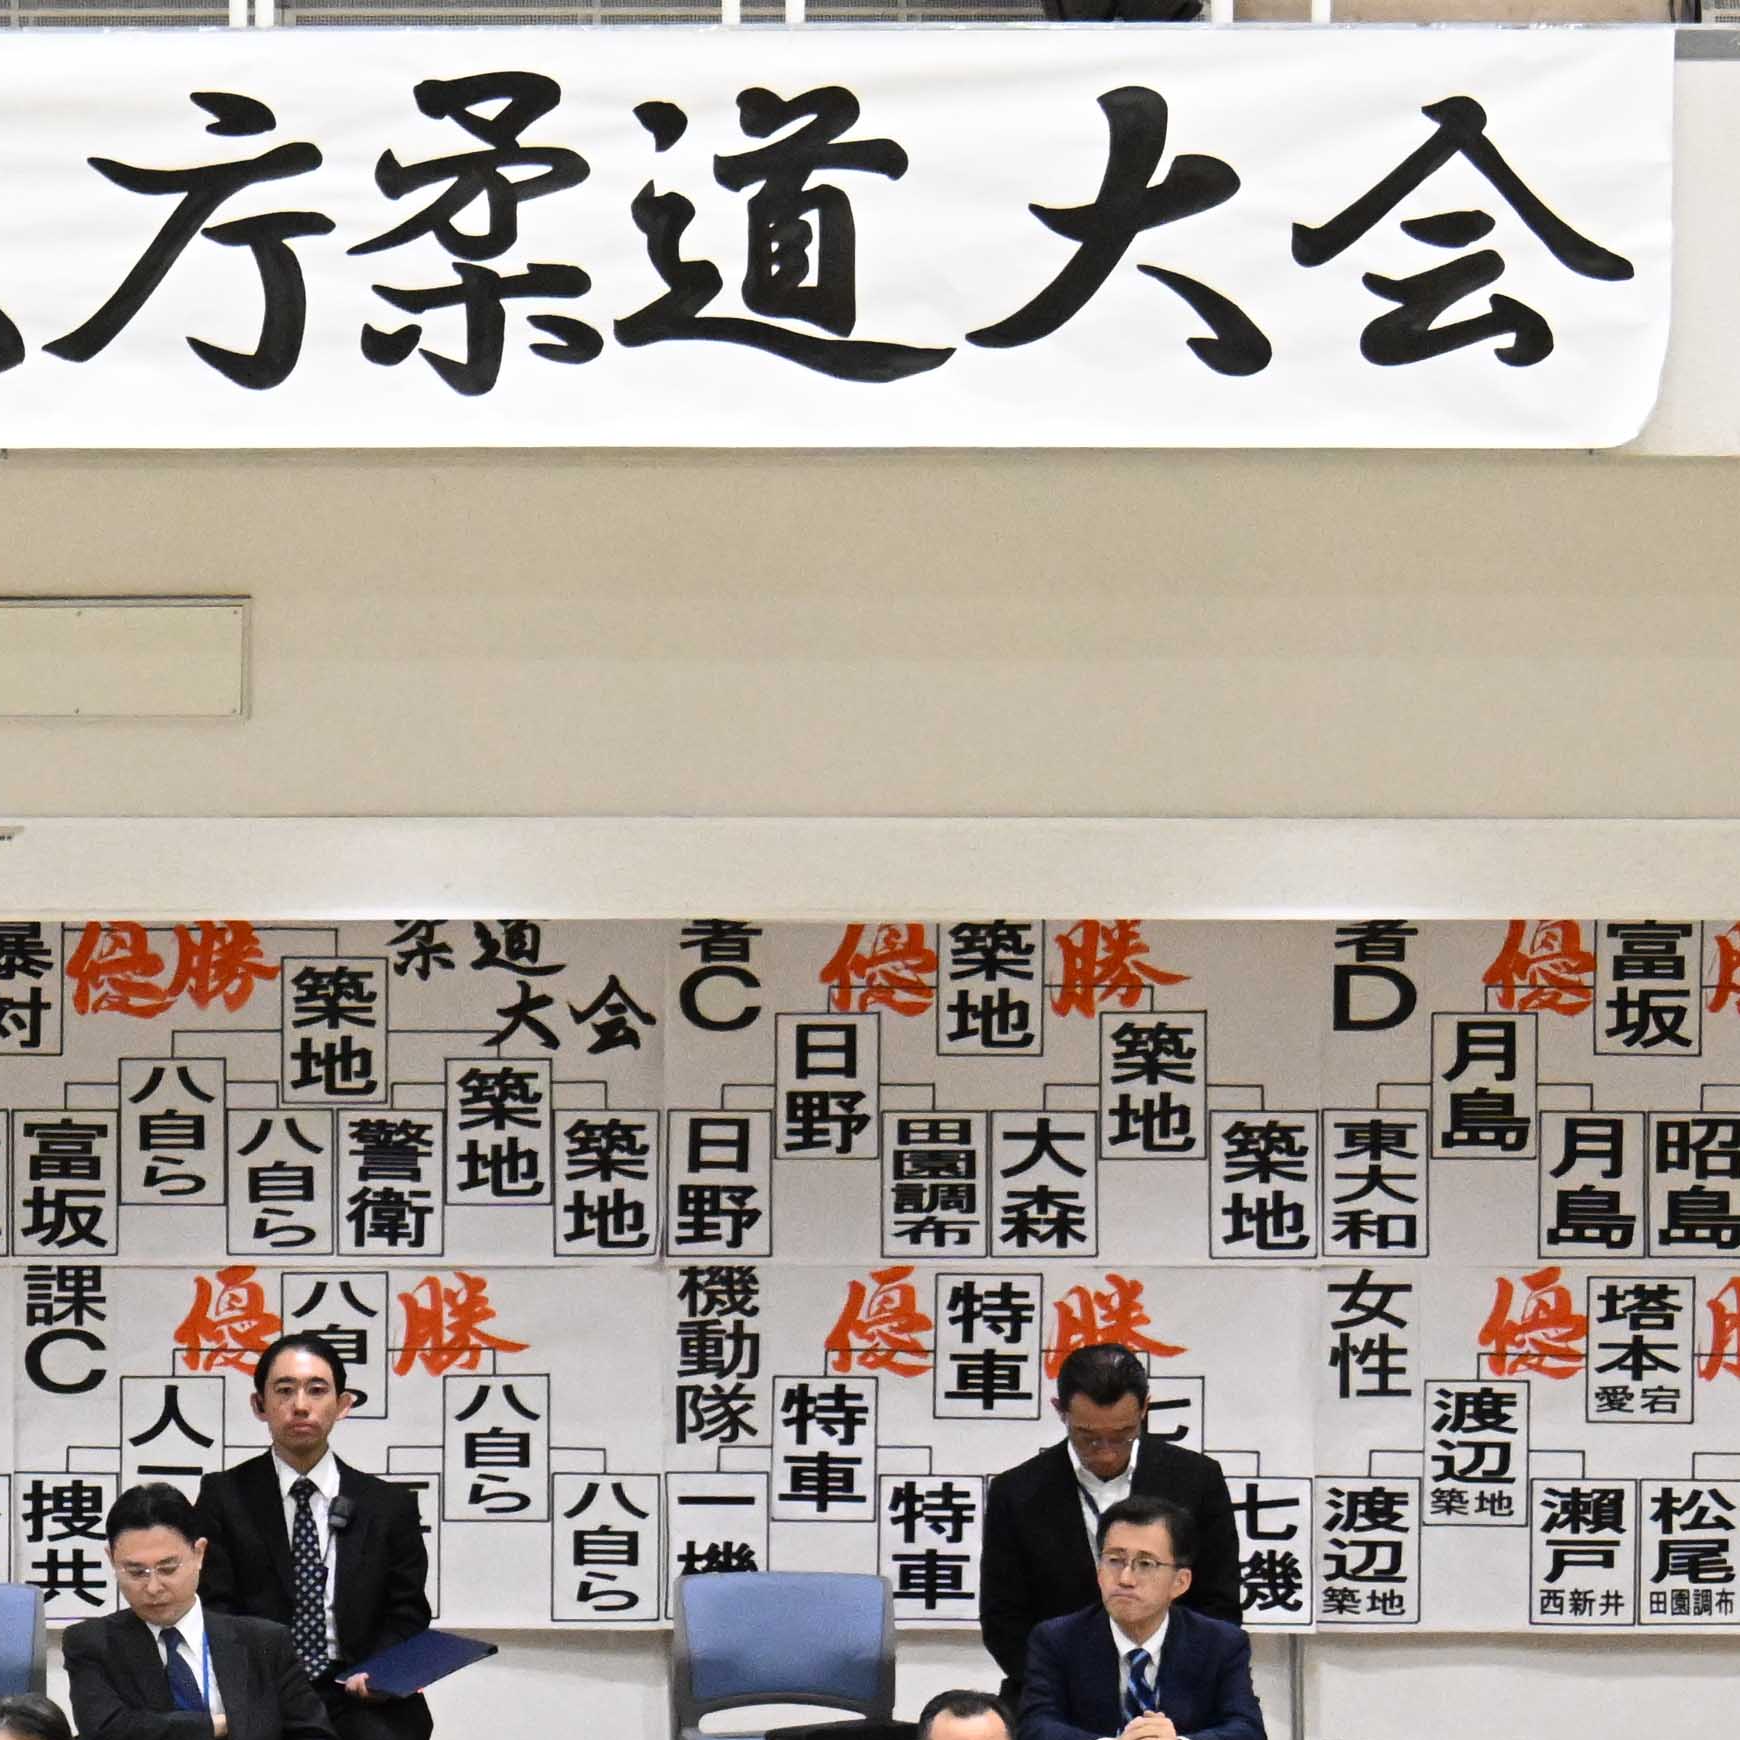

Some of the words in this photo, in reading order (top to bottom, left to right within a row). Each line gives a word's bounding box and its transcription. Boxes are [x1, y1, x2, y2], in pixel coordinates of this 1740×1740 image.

[65, 921, 281, 1020] 優勝
[290, 965, 378, 1096] 築地
[480, 973, 657, 1054] 大会
[679, 919, 763, 1032] 者C
[947, 921, 1036, 1049] 築地
[1332, 919, 1419, 1032] 者D
[1604, 920, 1693, 1049] 富坂
[128, 1065, 215, 1196] 八自ら
[456, 1066, 545, 1198] 築地
[783, 1023, 872, 1155] 日野
[1108, 1021, 1197, 1153] 築地
[1441, 1020, 1532, 1152] 月島
[20, 1117, 108, 1249] 富坂
[237, 1117, 324, 1248] 八自ら
[345, 1118, 434, 1248] 警衛
[563, 1118, 650, 1249] 築地
[674, 1117, 763, 1249] 日野
[890, 1118, 980, 1248] 田園調布
[999, 1117, 1087, 1249] 大森
[1221, 1119, 1310, 1251] 築地
[1331, 1119, 1419, 1250] 東大和
[1546, 1117, 1637, 1250] 月島
[1655, 1118, 1740, 1250] 昭島
[23, 1265, 107, 1395] 課C
[173, 1264, 283, 1377] 優
[393, 1271, 530, 1377] 勝
[291, 1281, 379, 1408] 八自
[675, 1266, 760, 1444] 機動隊
[824, 1264, 934, 1378] 優
[1044, 1272, 1187, 1380] 勝
[944, 1280, 1035, 1410] 特車
[1327, 1268, 1413, 1399] 女性
[1478, 1265, 1591, 1381] 優
[1594, 1283, 1683, 1382] 塔本
[455, 1384, 541, 1514] 八自ら
[778, 1383, 869, 1513] 特車
[1431, 1387, 1518, 1484] 渡辺
[1594, 1385, 1681, 1414] 愛宕
[21, 1479, 110, 1607] 捜共
[563, 1482, 649, 1612] 八自ら
[889, 1481, 976, 1610] 特車
[1322, 1486, 1410, 1583] 渡辺
[1430, 1487, 1514, 1517] 築地
[1650, 1487, 1737, 1584] 松尾
[1322, 1586, 1406, 1616] 築地
[1540, 1588, 1625, 1617] 西新井
[1649, 1588, 1735, 1616] 田園調布
